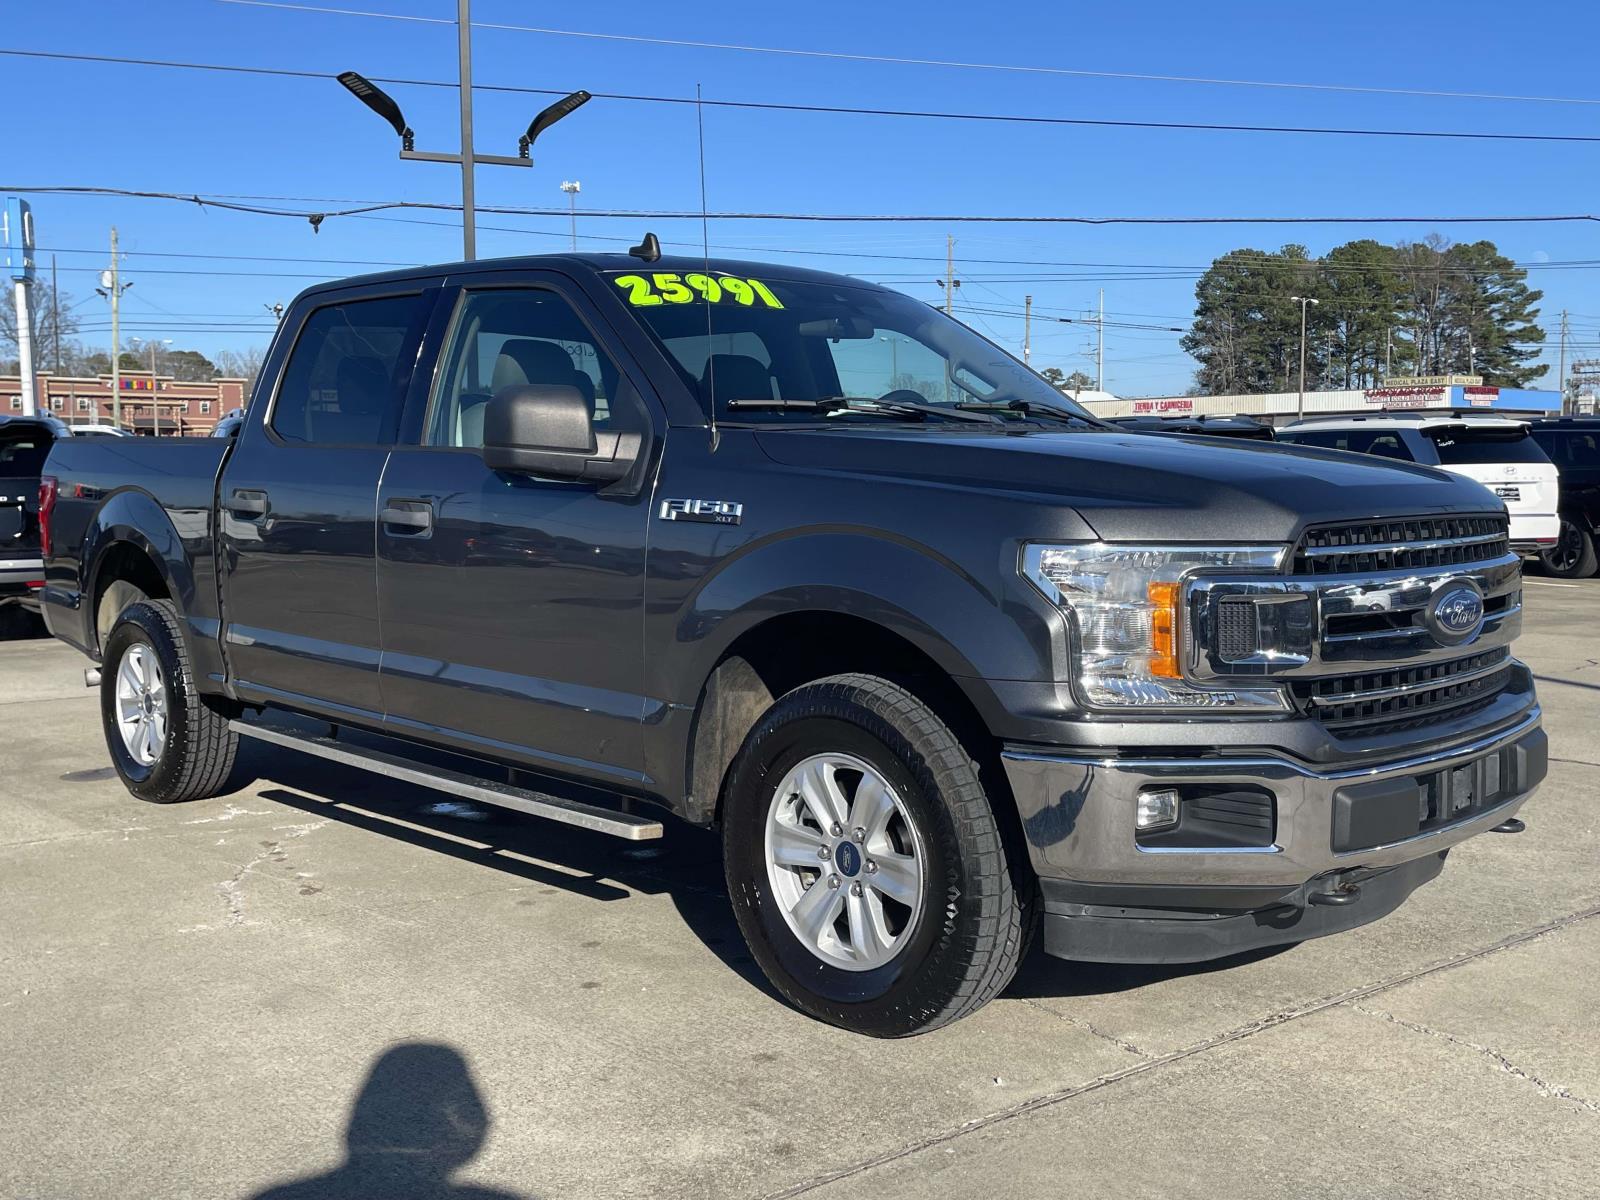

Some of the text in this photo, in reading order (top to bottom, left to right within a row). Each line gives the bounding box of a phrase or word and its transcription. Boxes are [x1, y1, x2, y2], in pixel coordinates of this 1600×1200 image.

[614, 273, 785, 309] 25991
[1385, 378, 1409, 386] MEDICAL
[715, 515, 733, 523] XLT
[1450, 599, 1477, 625] Ford
